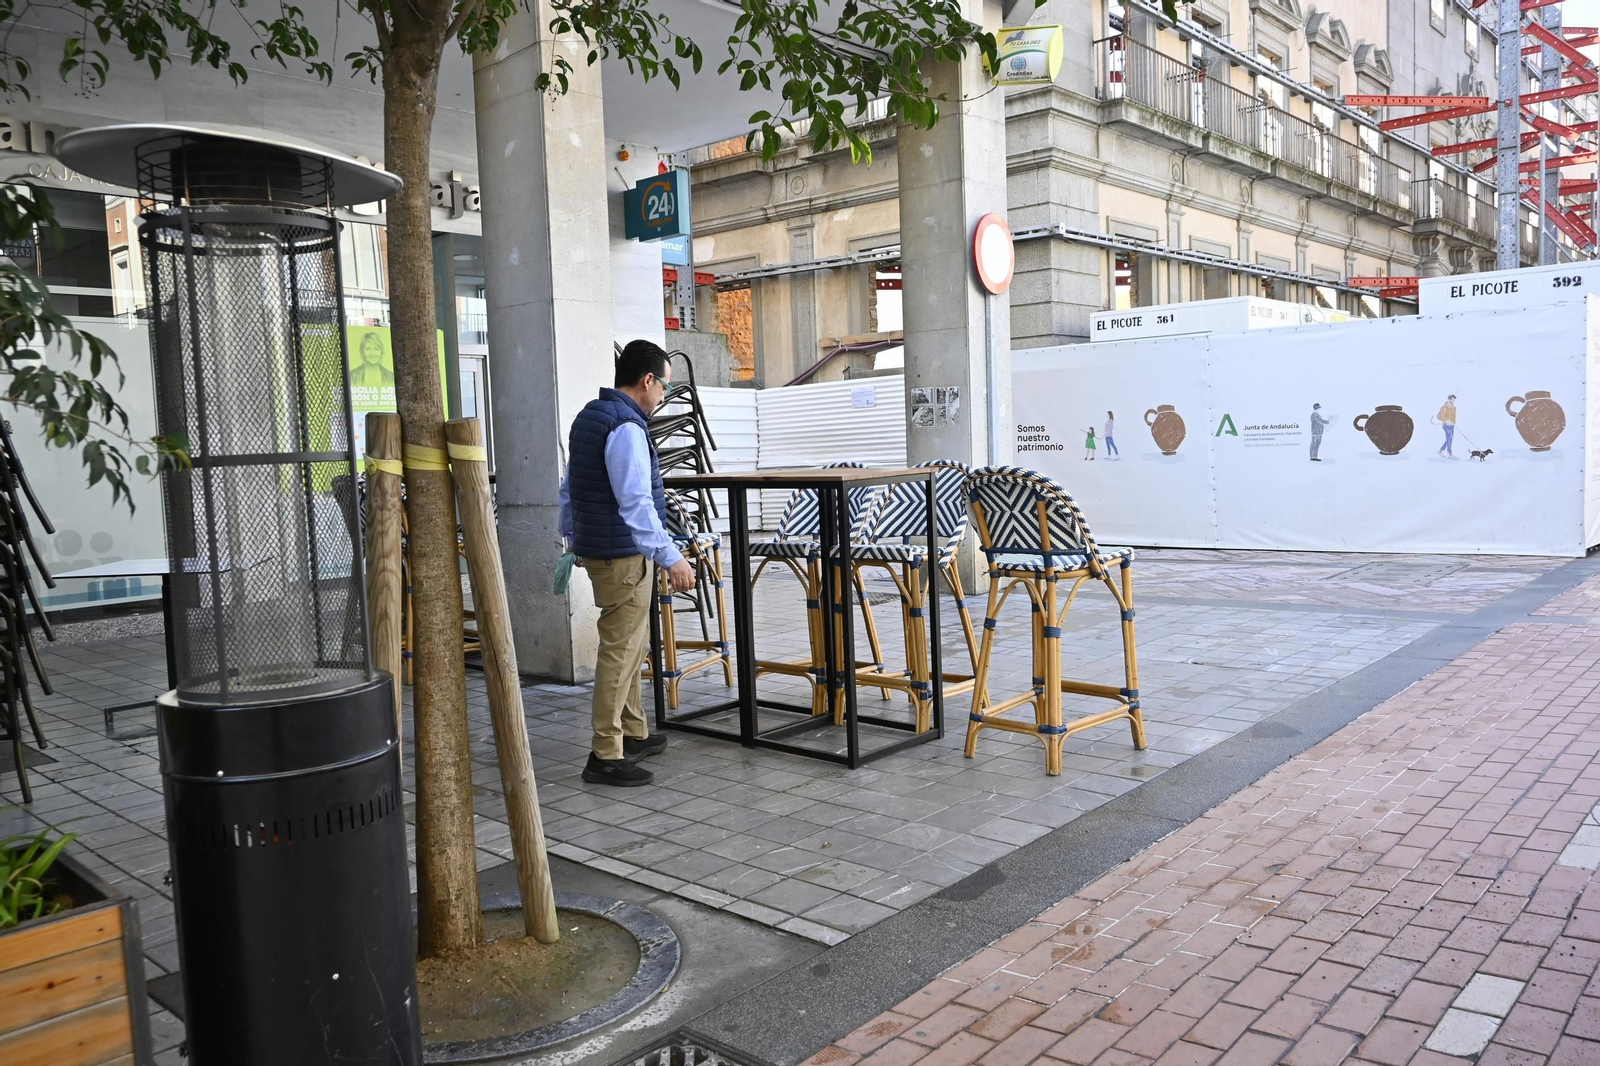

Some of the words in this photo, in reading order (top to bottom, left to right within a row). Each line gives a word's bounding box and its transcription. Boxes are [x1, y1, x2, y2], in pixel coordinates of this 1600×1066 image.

[28, 162, 83, 184] CAJA
[430, 169, 481, 219] aja
[660, 240, 684, 251] amar
[1451, 286, 1465, 298] EL
[1472, 280, 1519, 296] PICOTE
[1552, 275, 1582, 288] 392
[1097, 320, 1107, 330] EL
[1111, 316, 1142, 329] PICOTE
[1156, 313, 1174, 324] 361
[1017, 424, 1046, 433] Somos
[1270, 422, 1300, 430] Andalucía
[1017, 434, 1051, 442] nuestro
[1017, 442, 1064, 453] patrimonio
